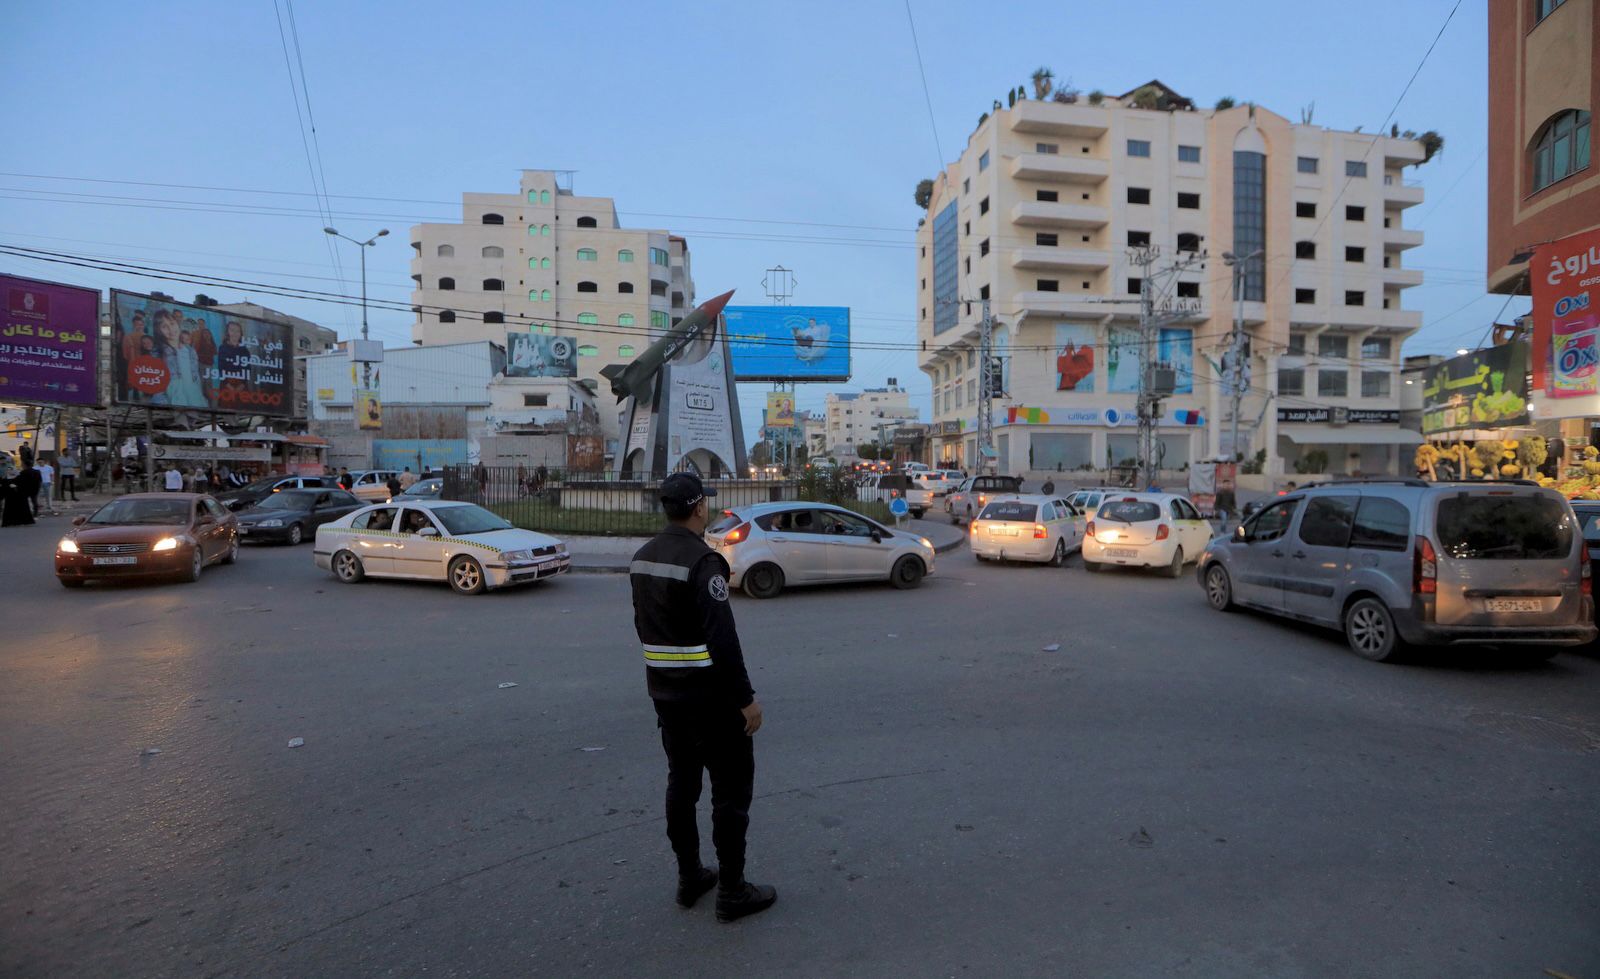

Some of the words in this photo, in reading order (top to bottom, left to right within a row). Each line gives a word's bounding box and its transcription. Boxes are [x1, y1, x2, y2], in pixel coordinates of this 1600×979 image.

[3, 323, 34, 337] كان
[38, 327, 55, 338] ما
[58, 330, 86, 343] شو
[263, 339, 283, 354] في
[134, 365, 165, 377] رمضان
[202, 367, 251, 381] السرور
[139, 376, 161, 386] كريم
